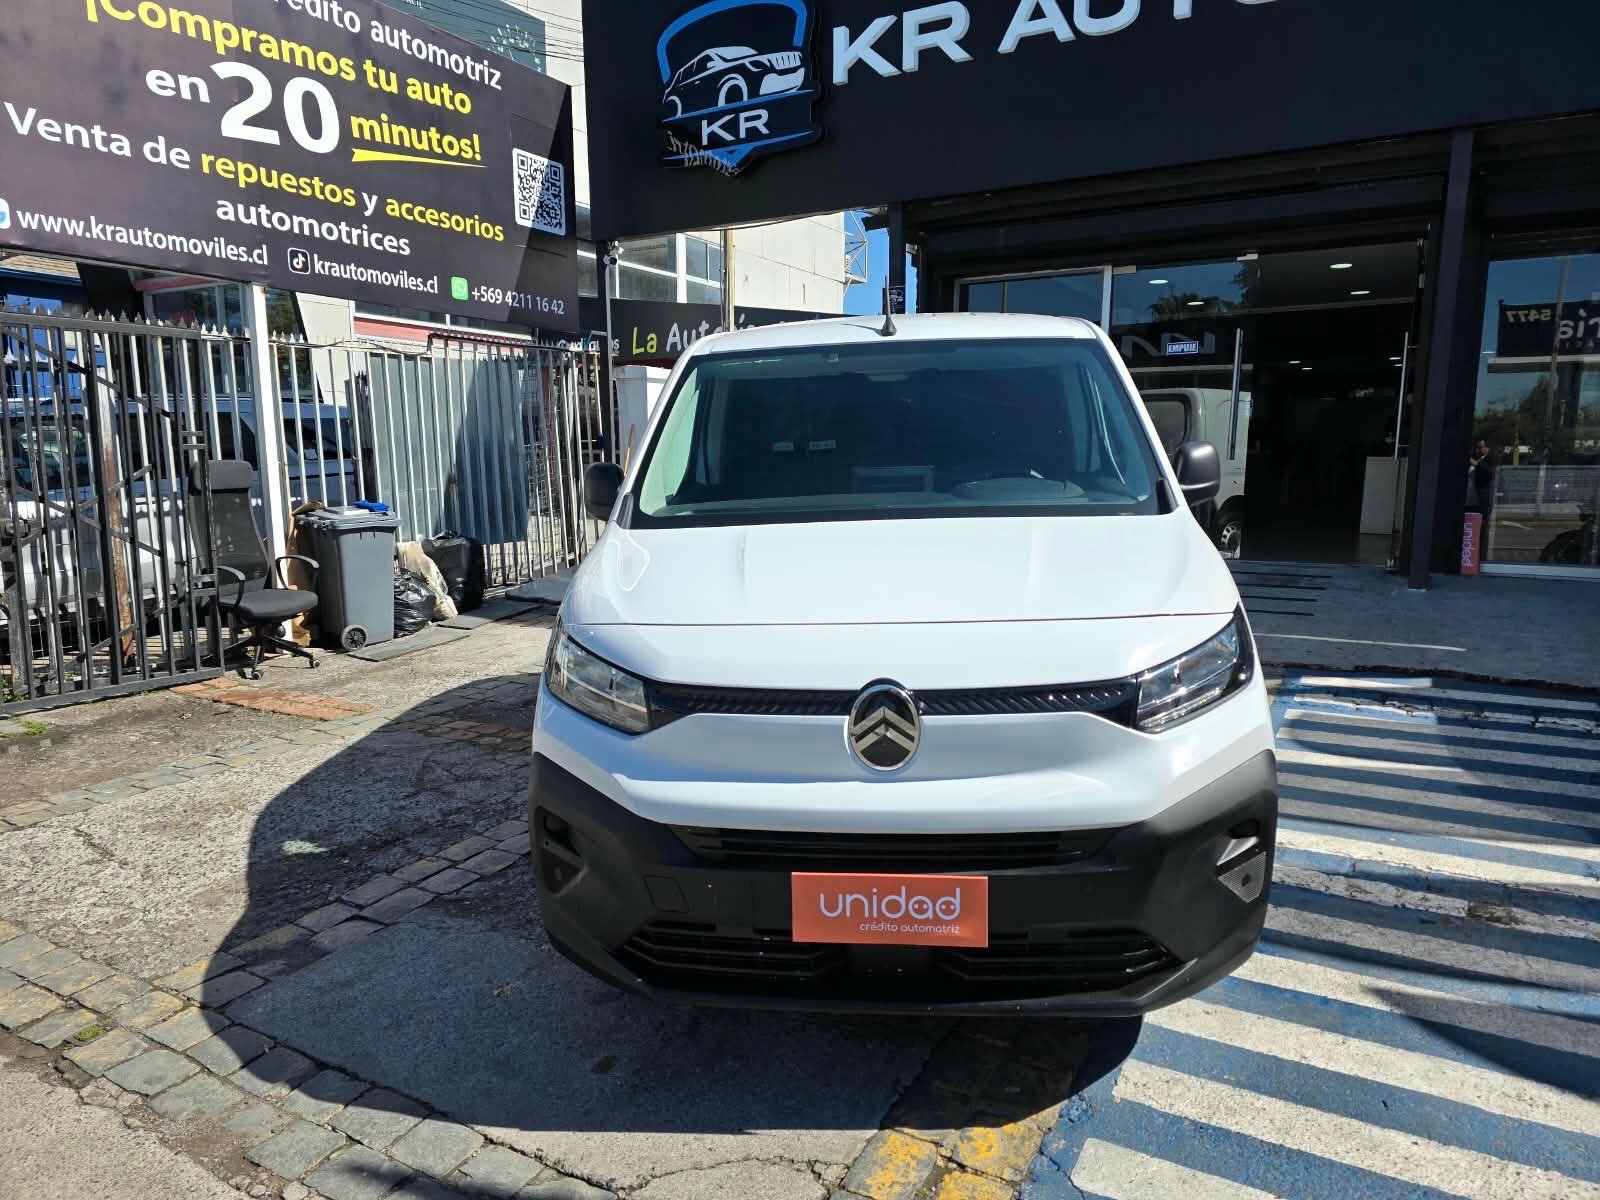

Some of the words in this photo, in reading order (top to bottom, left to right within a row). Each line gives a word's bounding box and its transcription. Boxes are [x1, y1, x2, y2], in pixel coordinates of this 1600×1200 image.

[370, 20, 502, 90] automotriz
[832, 0, 974, 85] KR
[363, 59, 398, 94] tu
[406, 77, 472, 114] auto
[146, 69, 210, 103] en
[210, 61, 340, 154] 20
[350, 113, 482, 160] minutos!
[701, 109, 770, 146] KR
[5, 102, 131, 157] Venta
[143, 136, 191, 169] de
[201, 153, 356, 206] repuestos
[361, 192, 378, 216] y
[386, 198, 504, 241] accesorios
[16, 209, 268, 265] www.krautomoviles.cl
[216, 199, 411, 255] automotrices
[314, 254, 438, 294] krautomoviles.cl
[472, 285, 502, 304] +569
[505, 290, 532, 310] 4211
[536, 296, 549, 312] 16
[551, 299, 565, 315] 42
[632, 326, 657, 355] La
[1168, 343, 1197, 353] EMPUJE
[819, 885, 961, 921] unidad
[860, 921, 898, 932] crédito
[900, 923, 960, 934] automotriz
